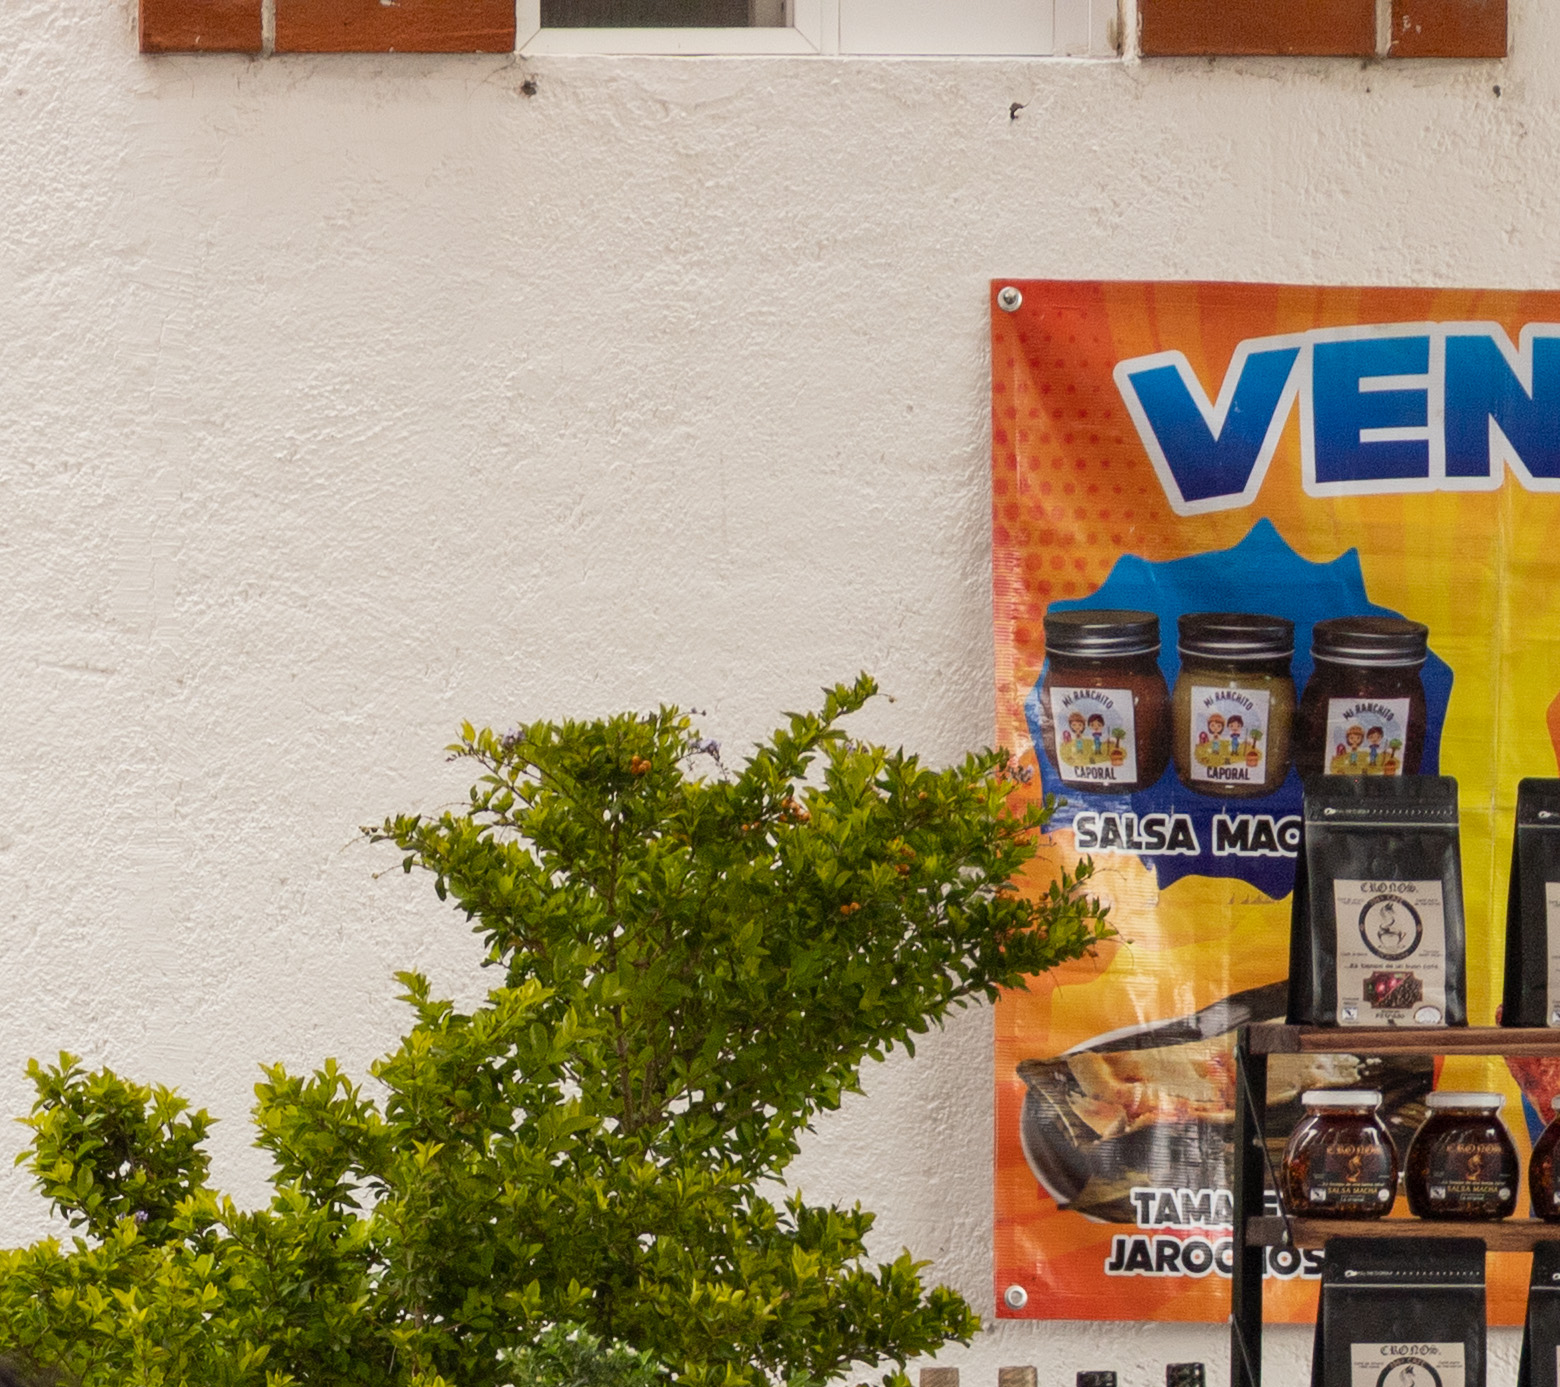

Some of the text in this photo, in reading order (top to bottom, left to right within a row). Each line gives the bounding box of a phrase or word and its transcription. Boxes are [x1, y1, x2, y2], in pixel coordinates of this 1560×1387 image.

[1073, 690, 1115, 710] RANCHITO
[1214, 690, 1254, 712] RANCHITO
[1354, 703, 1395, 723] RANCHITO
[1074, 766, 1117, 781] CAPORAL
[1207, 766, 1251, 781] CAPORAL
[1076, 815, 1301, 853] SALSA MAC
